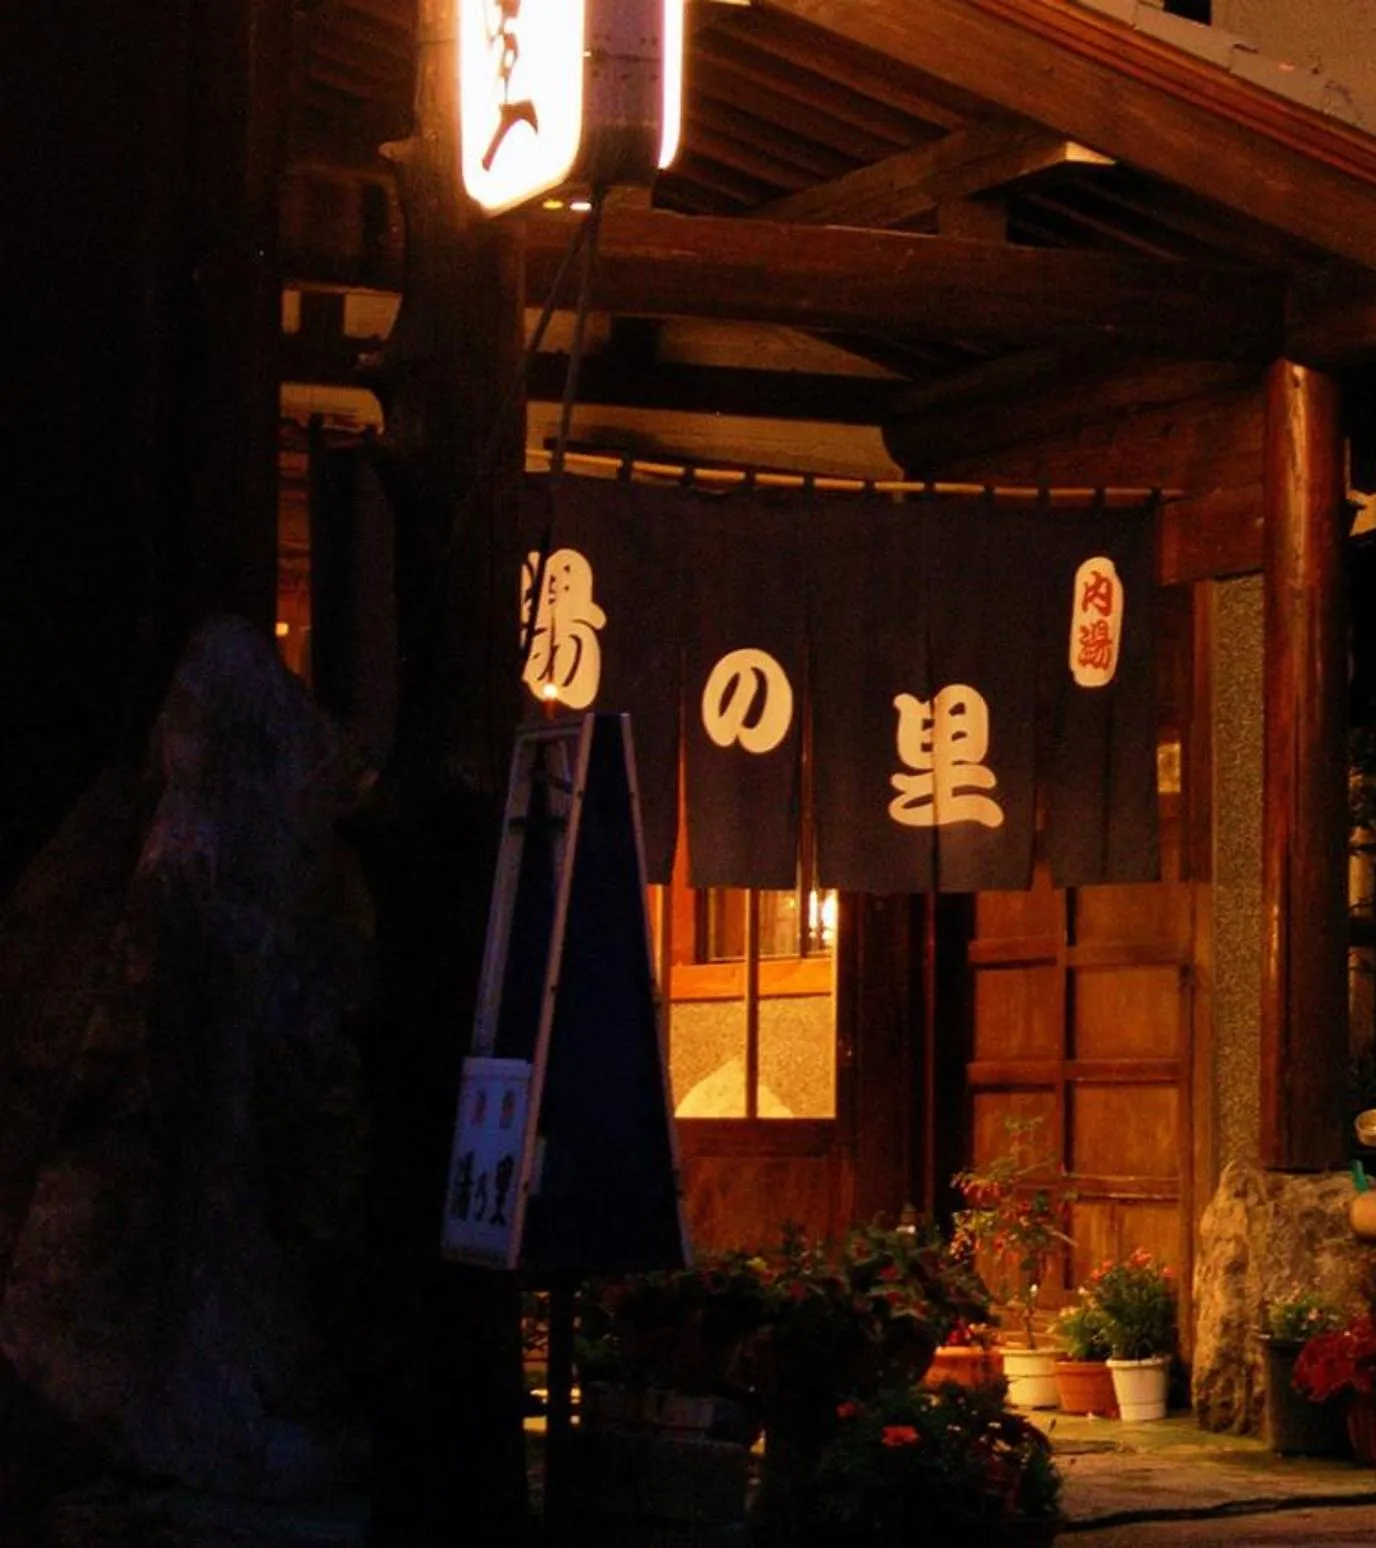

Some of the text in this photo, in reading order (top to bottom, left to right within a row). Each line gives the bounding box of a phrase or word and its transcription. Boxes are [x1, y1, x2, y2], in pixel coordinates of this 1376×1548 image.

[519, 548, 1004, 828] 湯の里
[1077, 570, 1113, 670] 内湯
